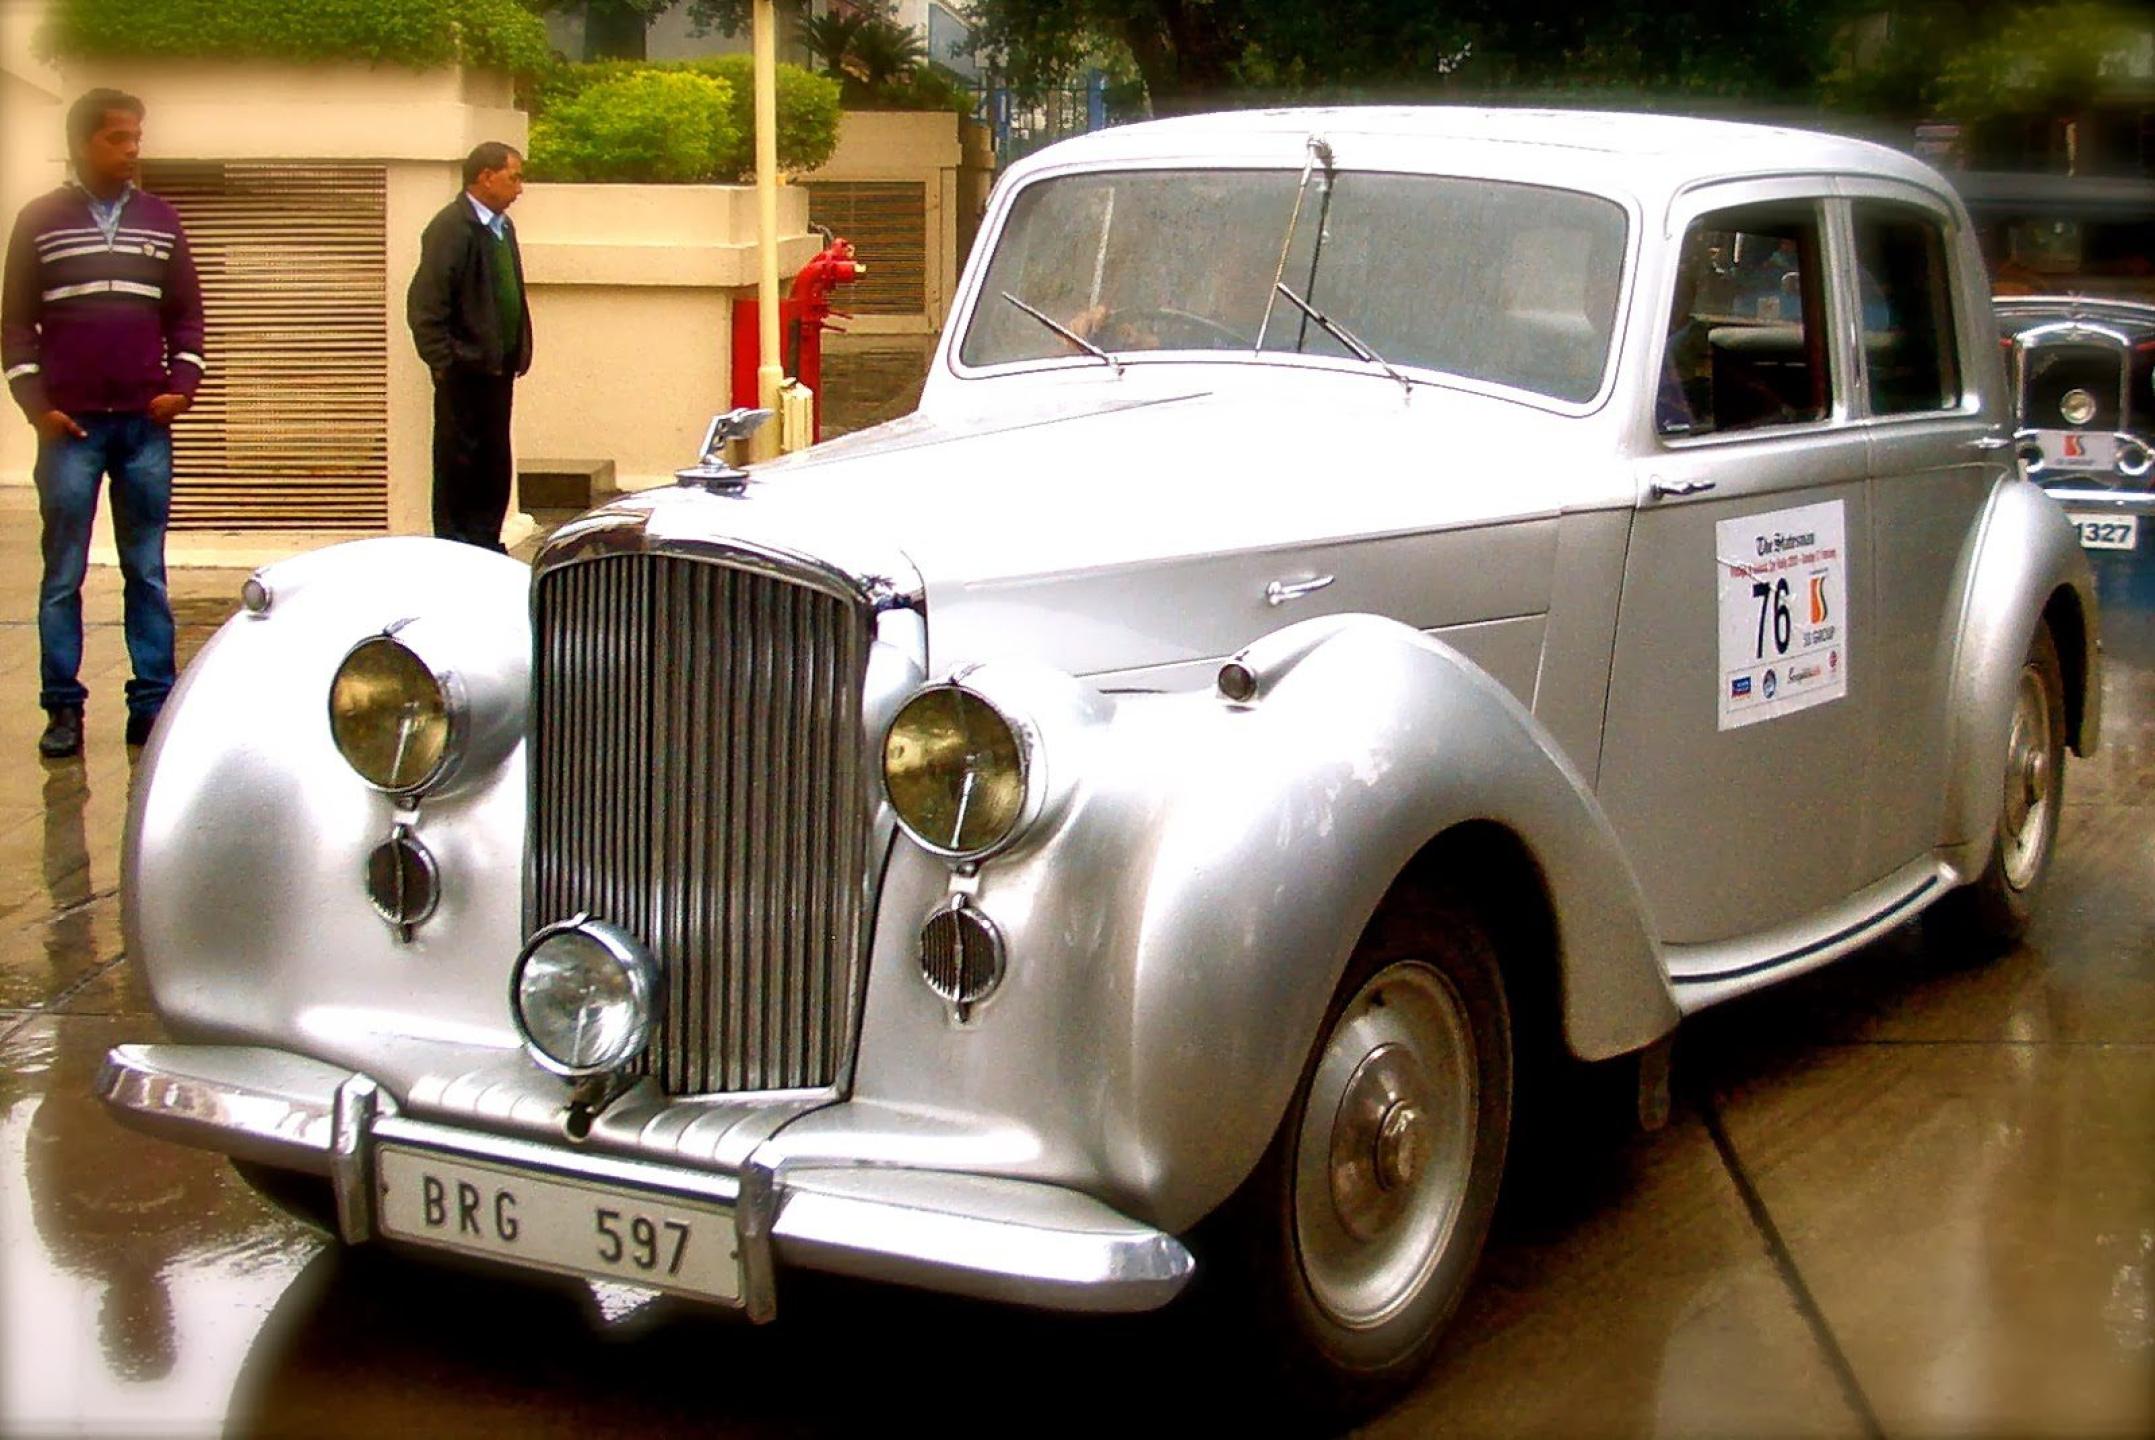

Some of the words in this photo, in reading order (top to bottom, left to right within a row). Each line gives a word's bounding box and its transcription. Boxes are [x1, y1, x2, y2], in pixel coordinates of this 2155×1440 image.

[1756, 536, 1772, 556] The
[1752, 577, 1791, 659] 76
[422, 1175, 518, 1241] BRG
[594, 1209, 691, 1276] 597
